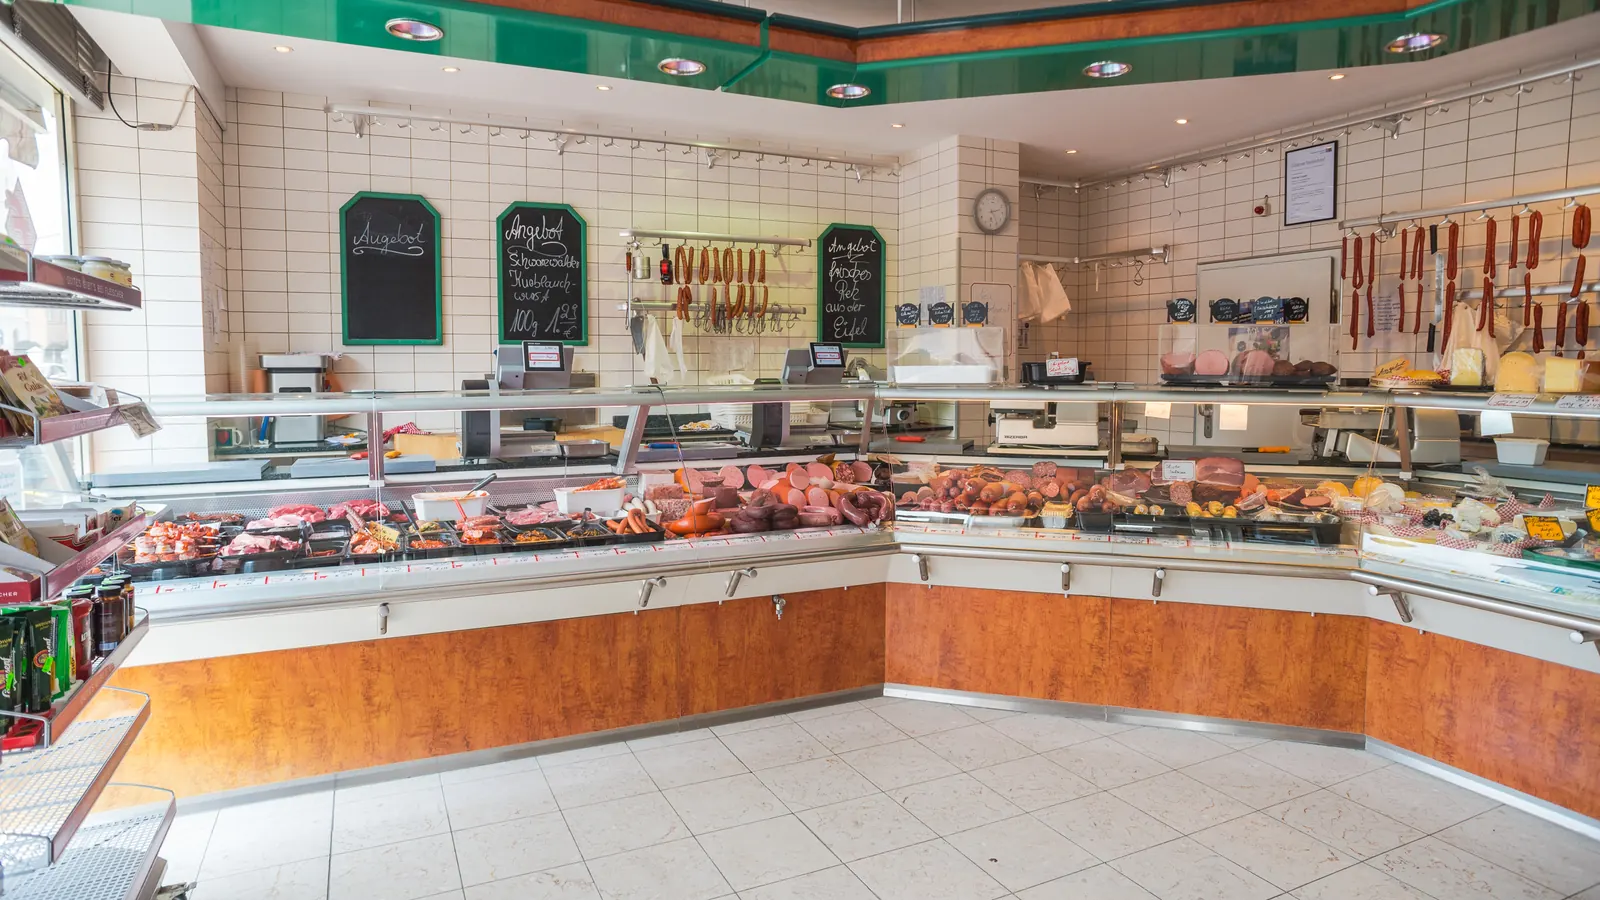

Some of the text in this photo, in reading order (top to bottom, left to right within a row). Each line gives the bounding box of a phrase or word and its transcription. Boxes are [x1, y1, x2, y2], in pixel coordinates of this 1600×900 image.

[504, 214, 564, 251] Angebot
[828, 237, 877, 259] Angebot
[829, 261, 872, 282] frisches
[835, 279, 860, 301] Reh
[825, 301, 866, 313] aus der
[509, 308, 538, 337] 100g
[833, 315, 868, 341] Eifel
